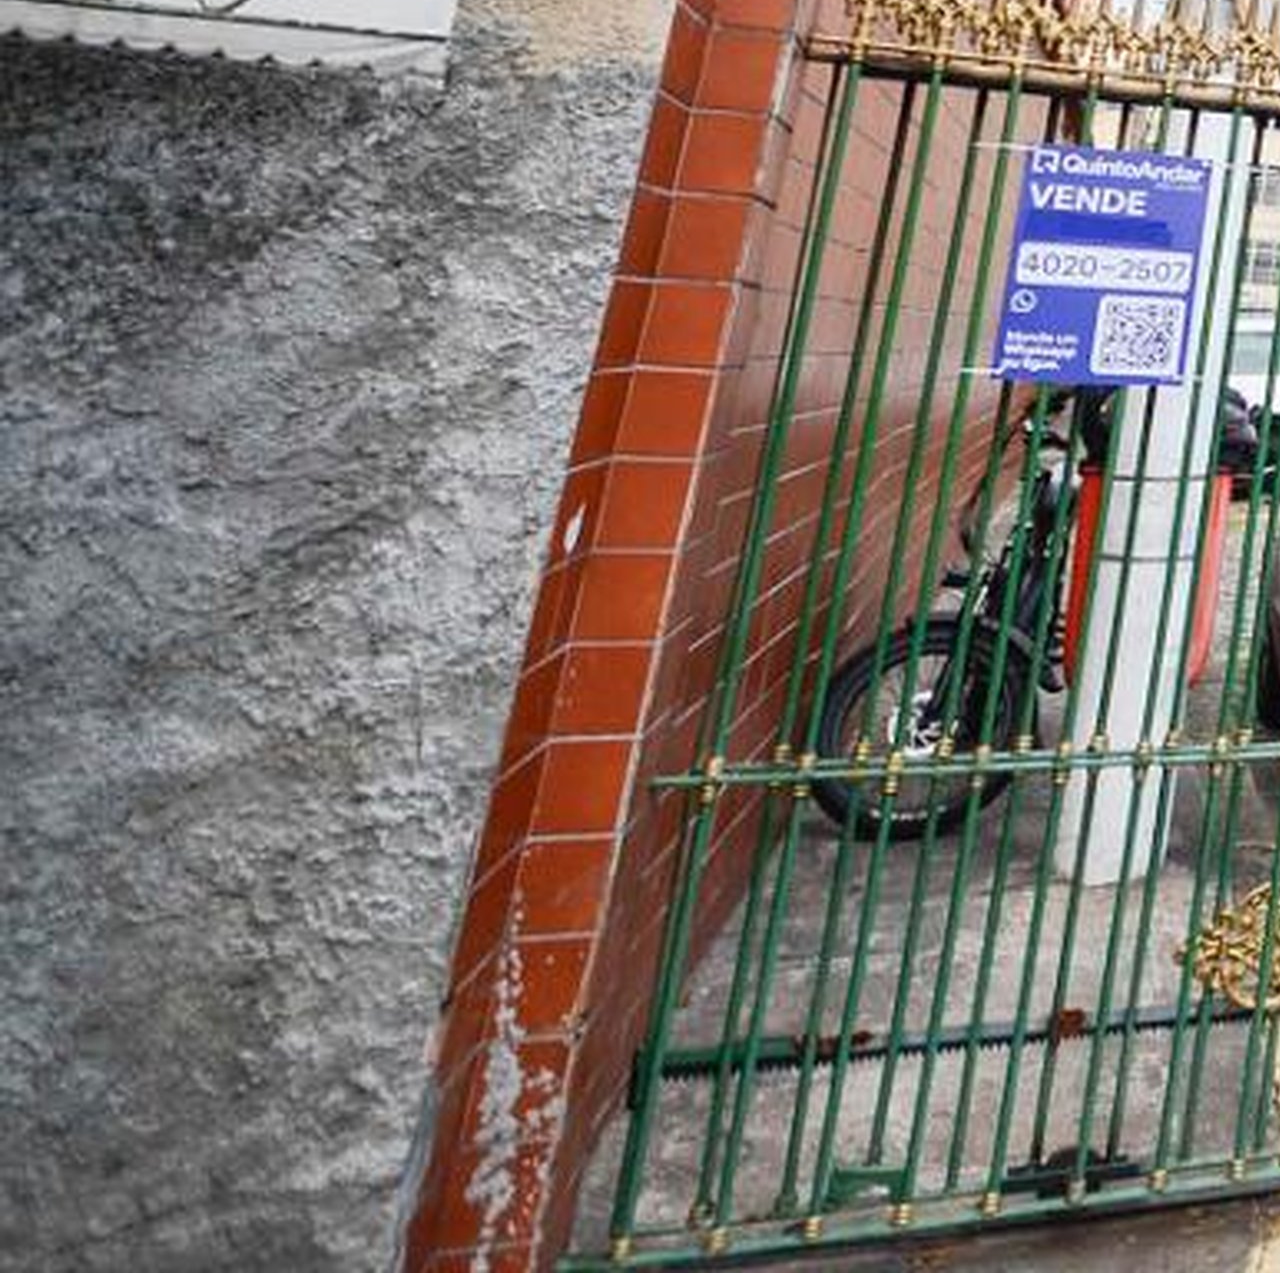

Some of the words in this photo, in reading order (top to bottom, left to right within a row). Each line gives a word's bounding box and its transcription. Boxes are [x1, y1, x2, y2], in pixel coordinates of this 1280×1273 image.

[1062, 152, 1204, 183] QuintoAndar
[1029, 181, 1148, 217] VENDE
[1023, 250, 1188, 284] 4020-2507
